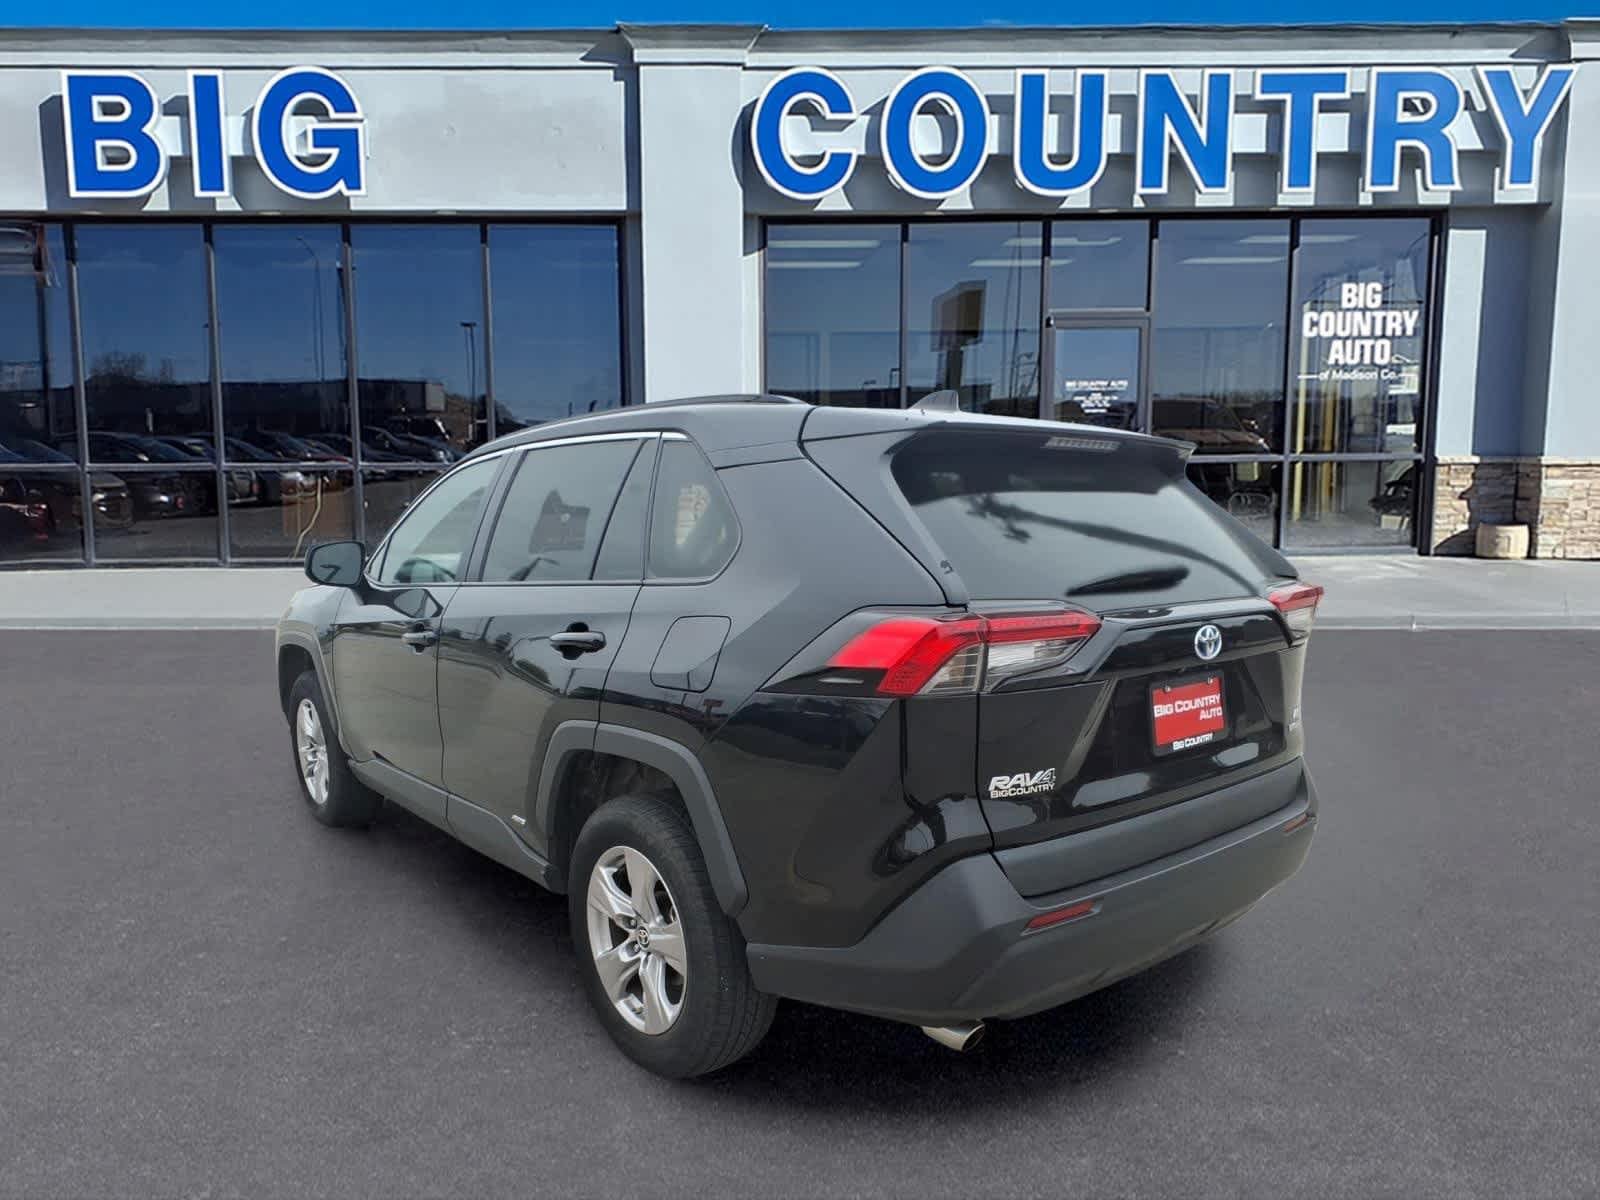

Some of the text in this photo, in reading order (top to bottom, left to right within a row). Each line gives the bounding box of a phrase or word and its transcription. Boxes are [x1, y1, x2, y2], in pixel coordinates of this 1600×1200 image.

[61, 64, 1578, 200] BIG COUNTRY
[1341, 282, 1383, 309] BIG
[1303, 310, 1419, 337] COUNTRY
[1327, 339, 1391, 365] AUTO
[1332, 369, 1378, 380] Madison
[1153, 693, 1221, 718] BIG COUNTRY
[1200, 706, 1222, 720] AUTO
[1184, 732, 1214, 747] COUNTRY
[988, 767, 1056, 791] RAV4
